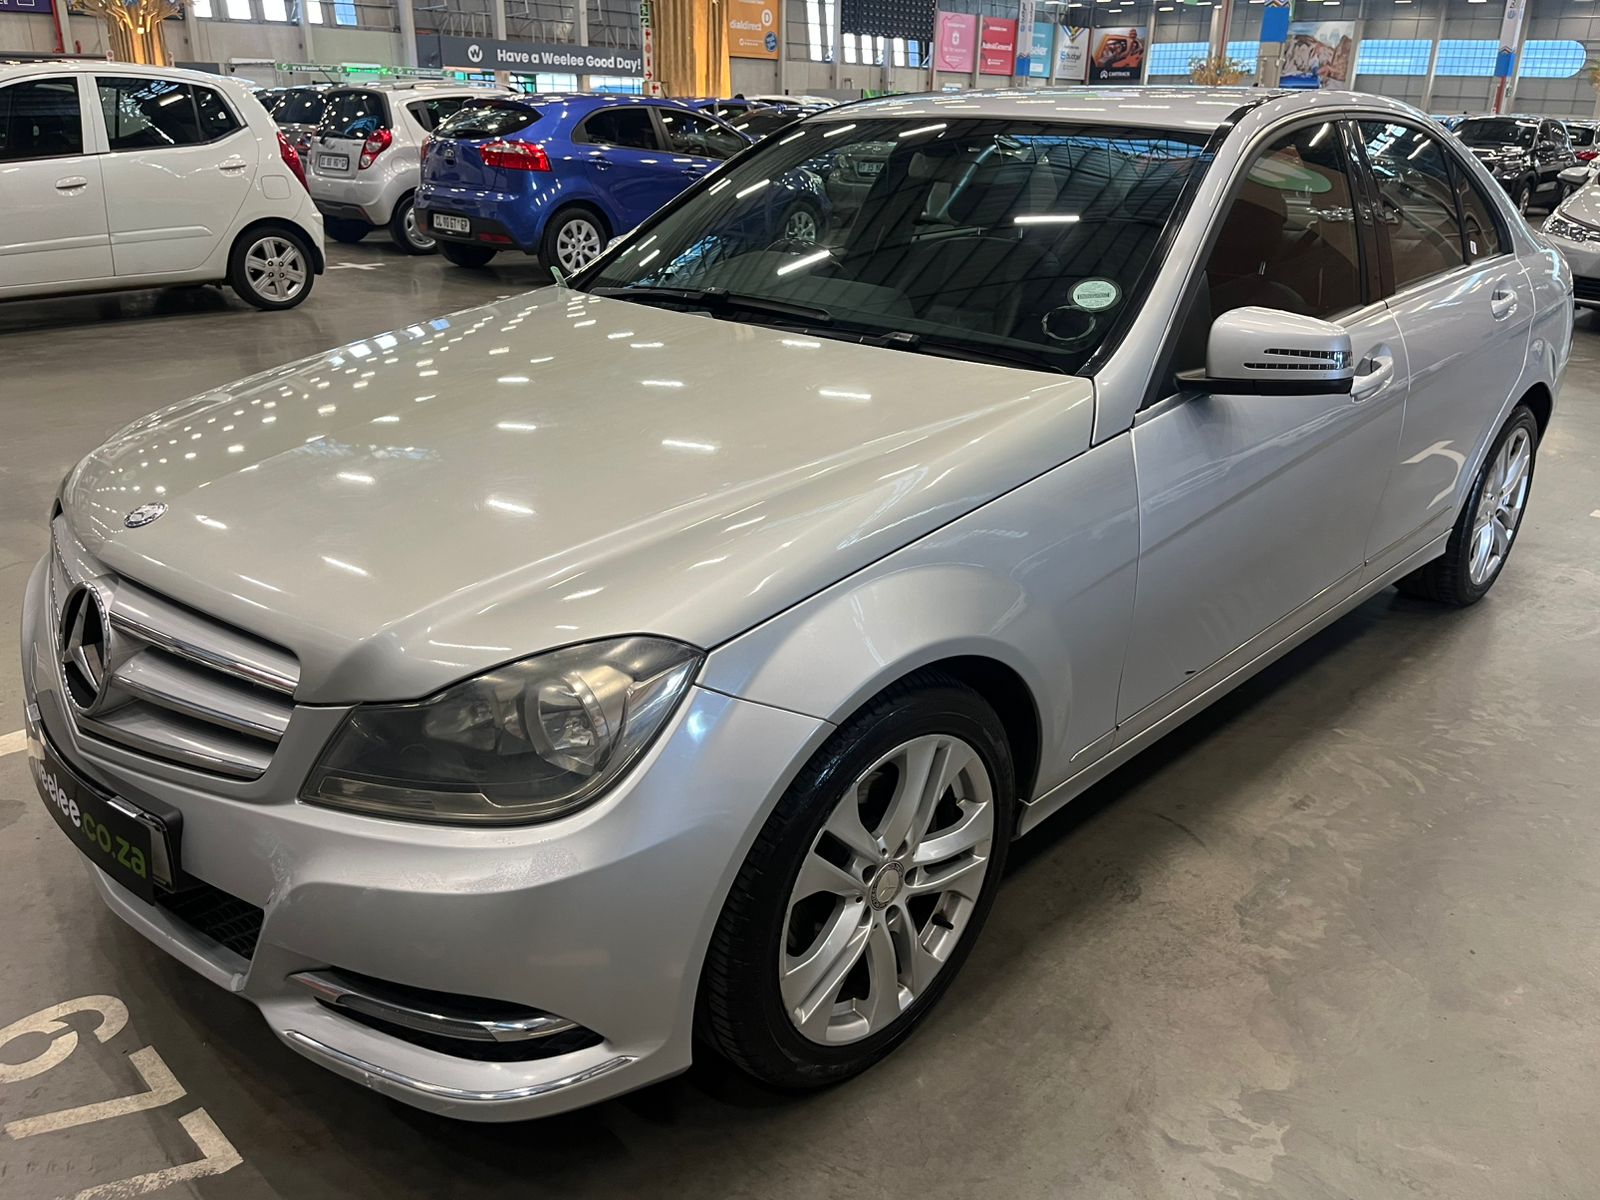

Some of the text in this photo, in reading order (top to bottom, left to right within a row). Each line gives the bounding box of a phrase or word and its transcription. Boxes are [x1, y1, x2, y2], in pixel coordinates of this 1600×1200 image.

[497, 49, 642, 73] Have a Weelee Good Day!
